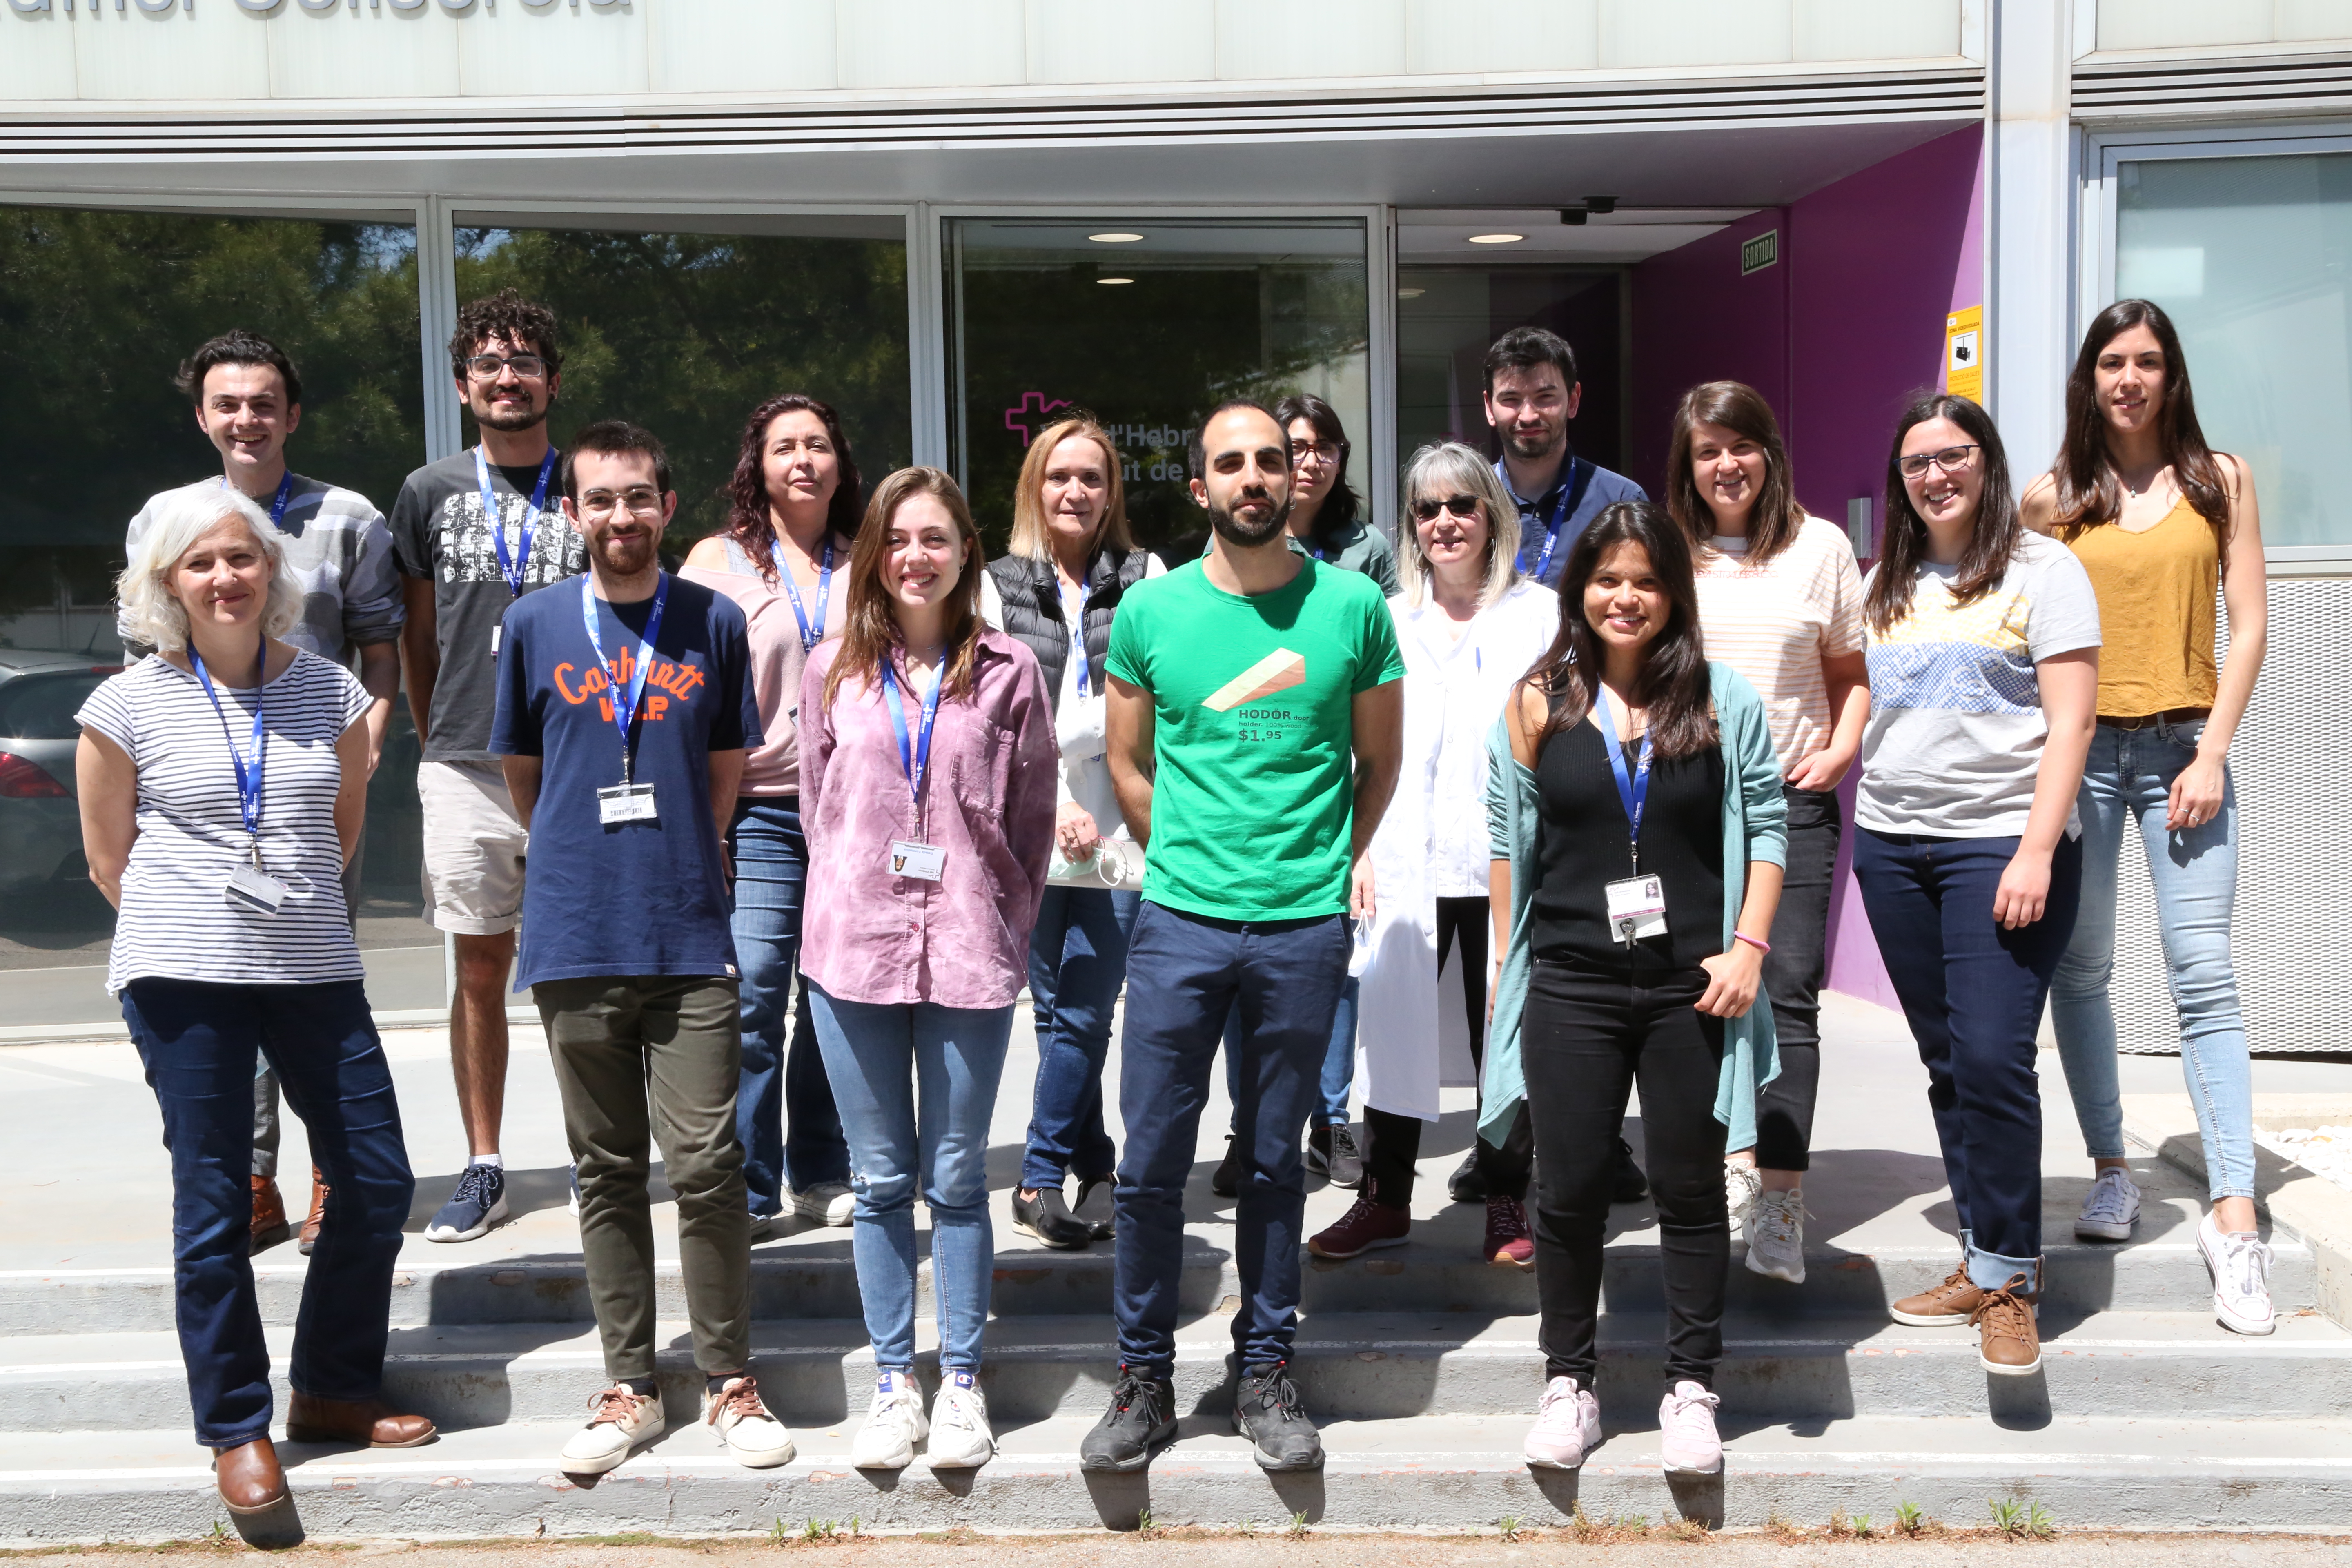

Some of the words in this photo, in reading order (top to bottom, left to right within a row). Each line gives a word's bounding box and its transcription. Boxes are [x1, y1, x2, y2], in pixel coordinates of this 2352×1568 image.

[1745, 238, 1773, 268] SORTIDA
[1103, 424, 1193, 447] d'Hebr
[1150, 459, 1183, 481] de
[1239, 708, 1292, 720] HODÖR
[1238, 728, 1281, 743] $1.95
